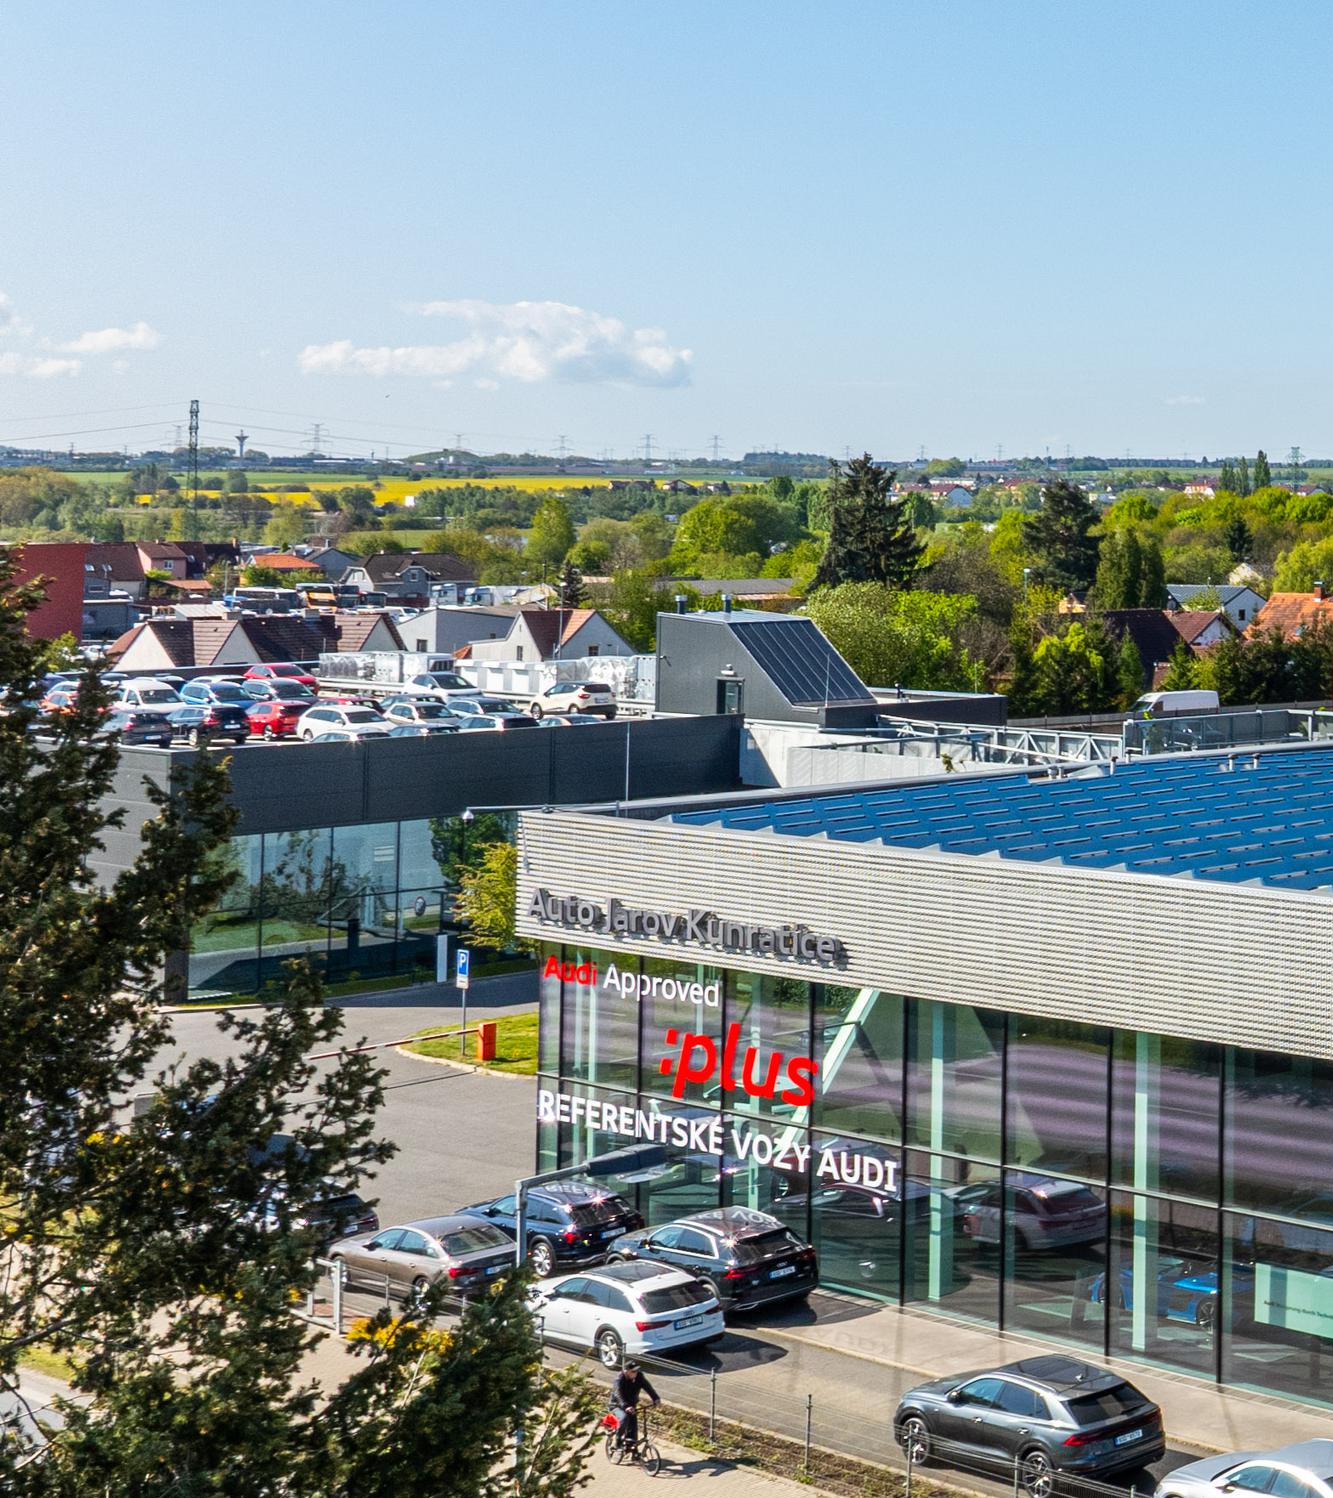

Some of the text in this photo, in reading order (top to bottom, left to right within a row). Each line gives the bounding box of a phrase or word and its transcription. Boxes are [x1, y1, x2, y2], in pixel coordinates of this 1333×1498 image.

[529, 888, 837, 961] Auto Jarov Kunratice
[544, 955, 719, 1007] Audi Approved
[538, 1090, 724, 1155] REFERENTSKÉ
[817, 1148, 902, 1192] AUDI
